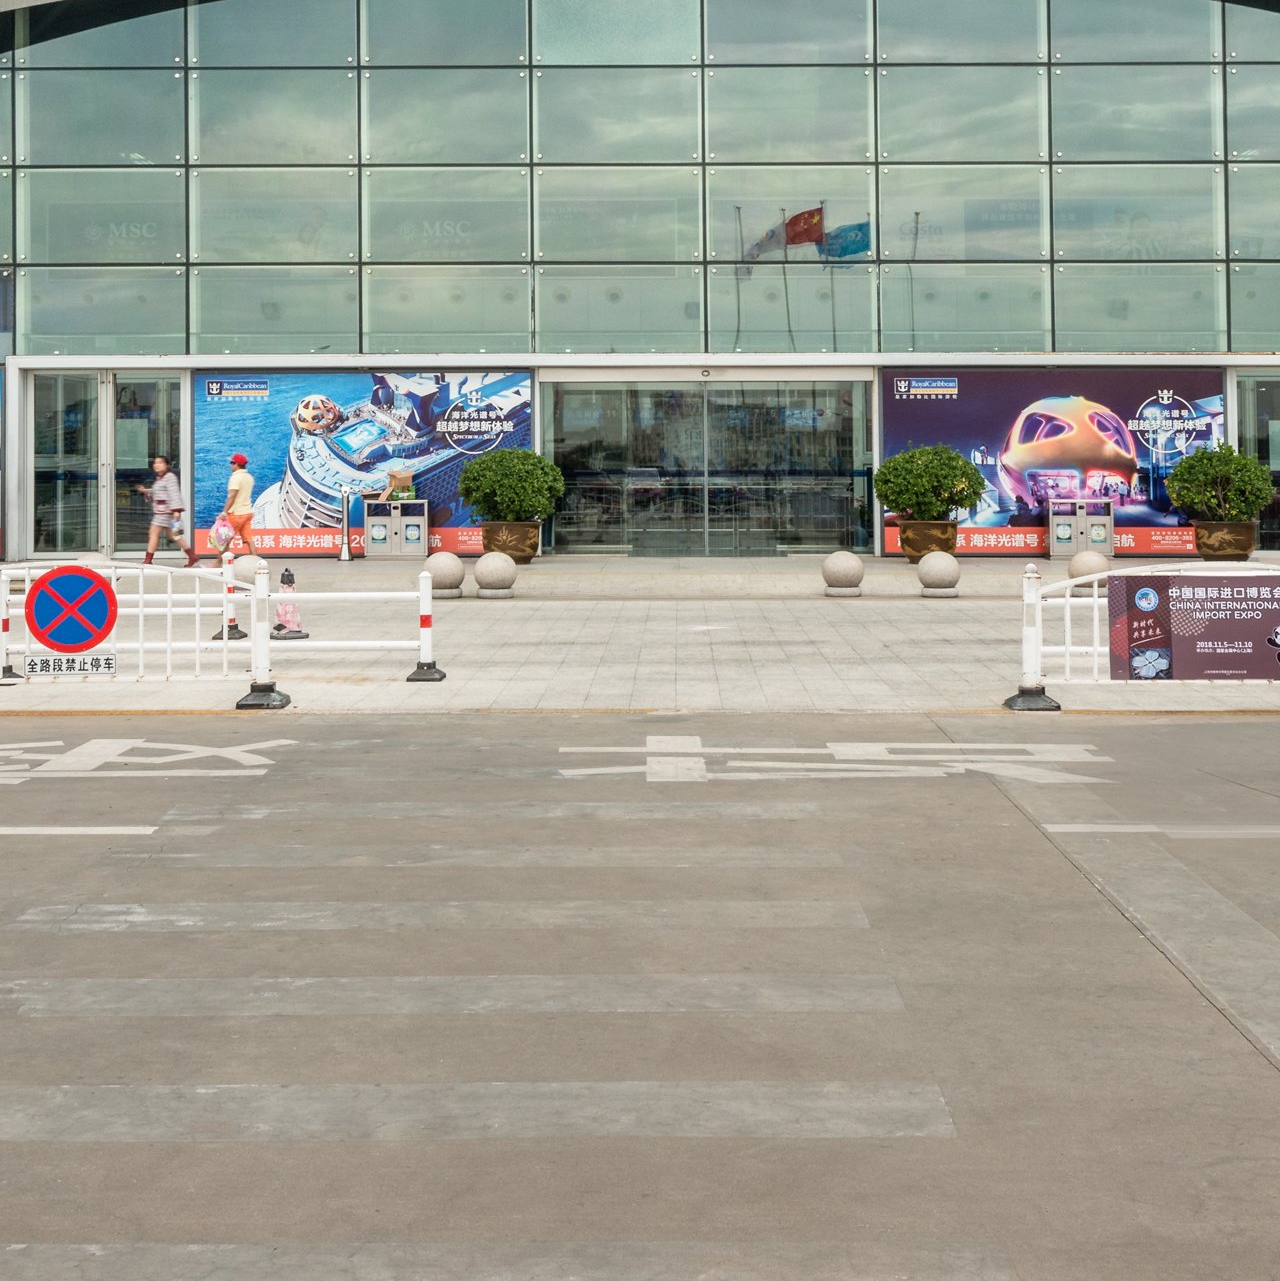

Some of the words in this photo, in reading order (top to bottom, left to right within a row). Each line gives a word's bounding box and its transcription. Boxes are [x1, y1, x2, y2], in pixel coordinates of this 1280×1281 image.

[108, 222, 158, 238] MSC
[422, 220, 472, 236] MSC
[436, 421, 514, 431] 超越梦想新体验
[1128, 420, 1206, 430] 超越梦想新体验
[970, 533, 1039, 547] 海洋光谱号
[1169, 601, 1201, 610] CHINA
[1193, 611, 1231, 619] IMPORT
[1235, 611, 1262, 619] EXPO
[27, 657, 114, 673] 全路段禁止停车
